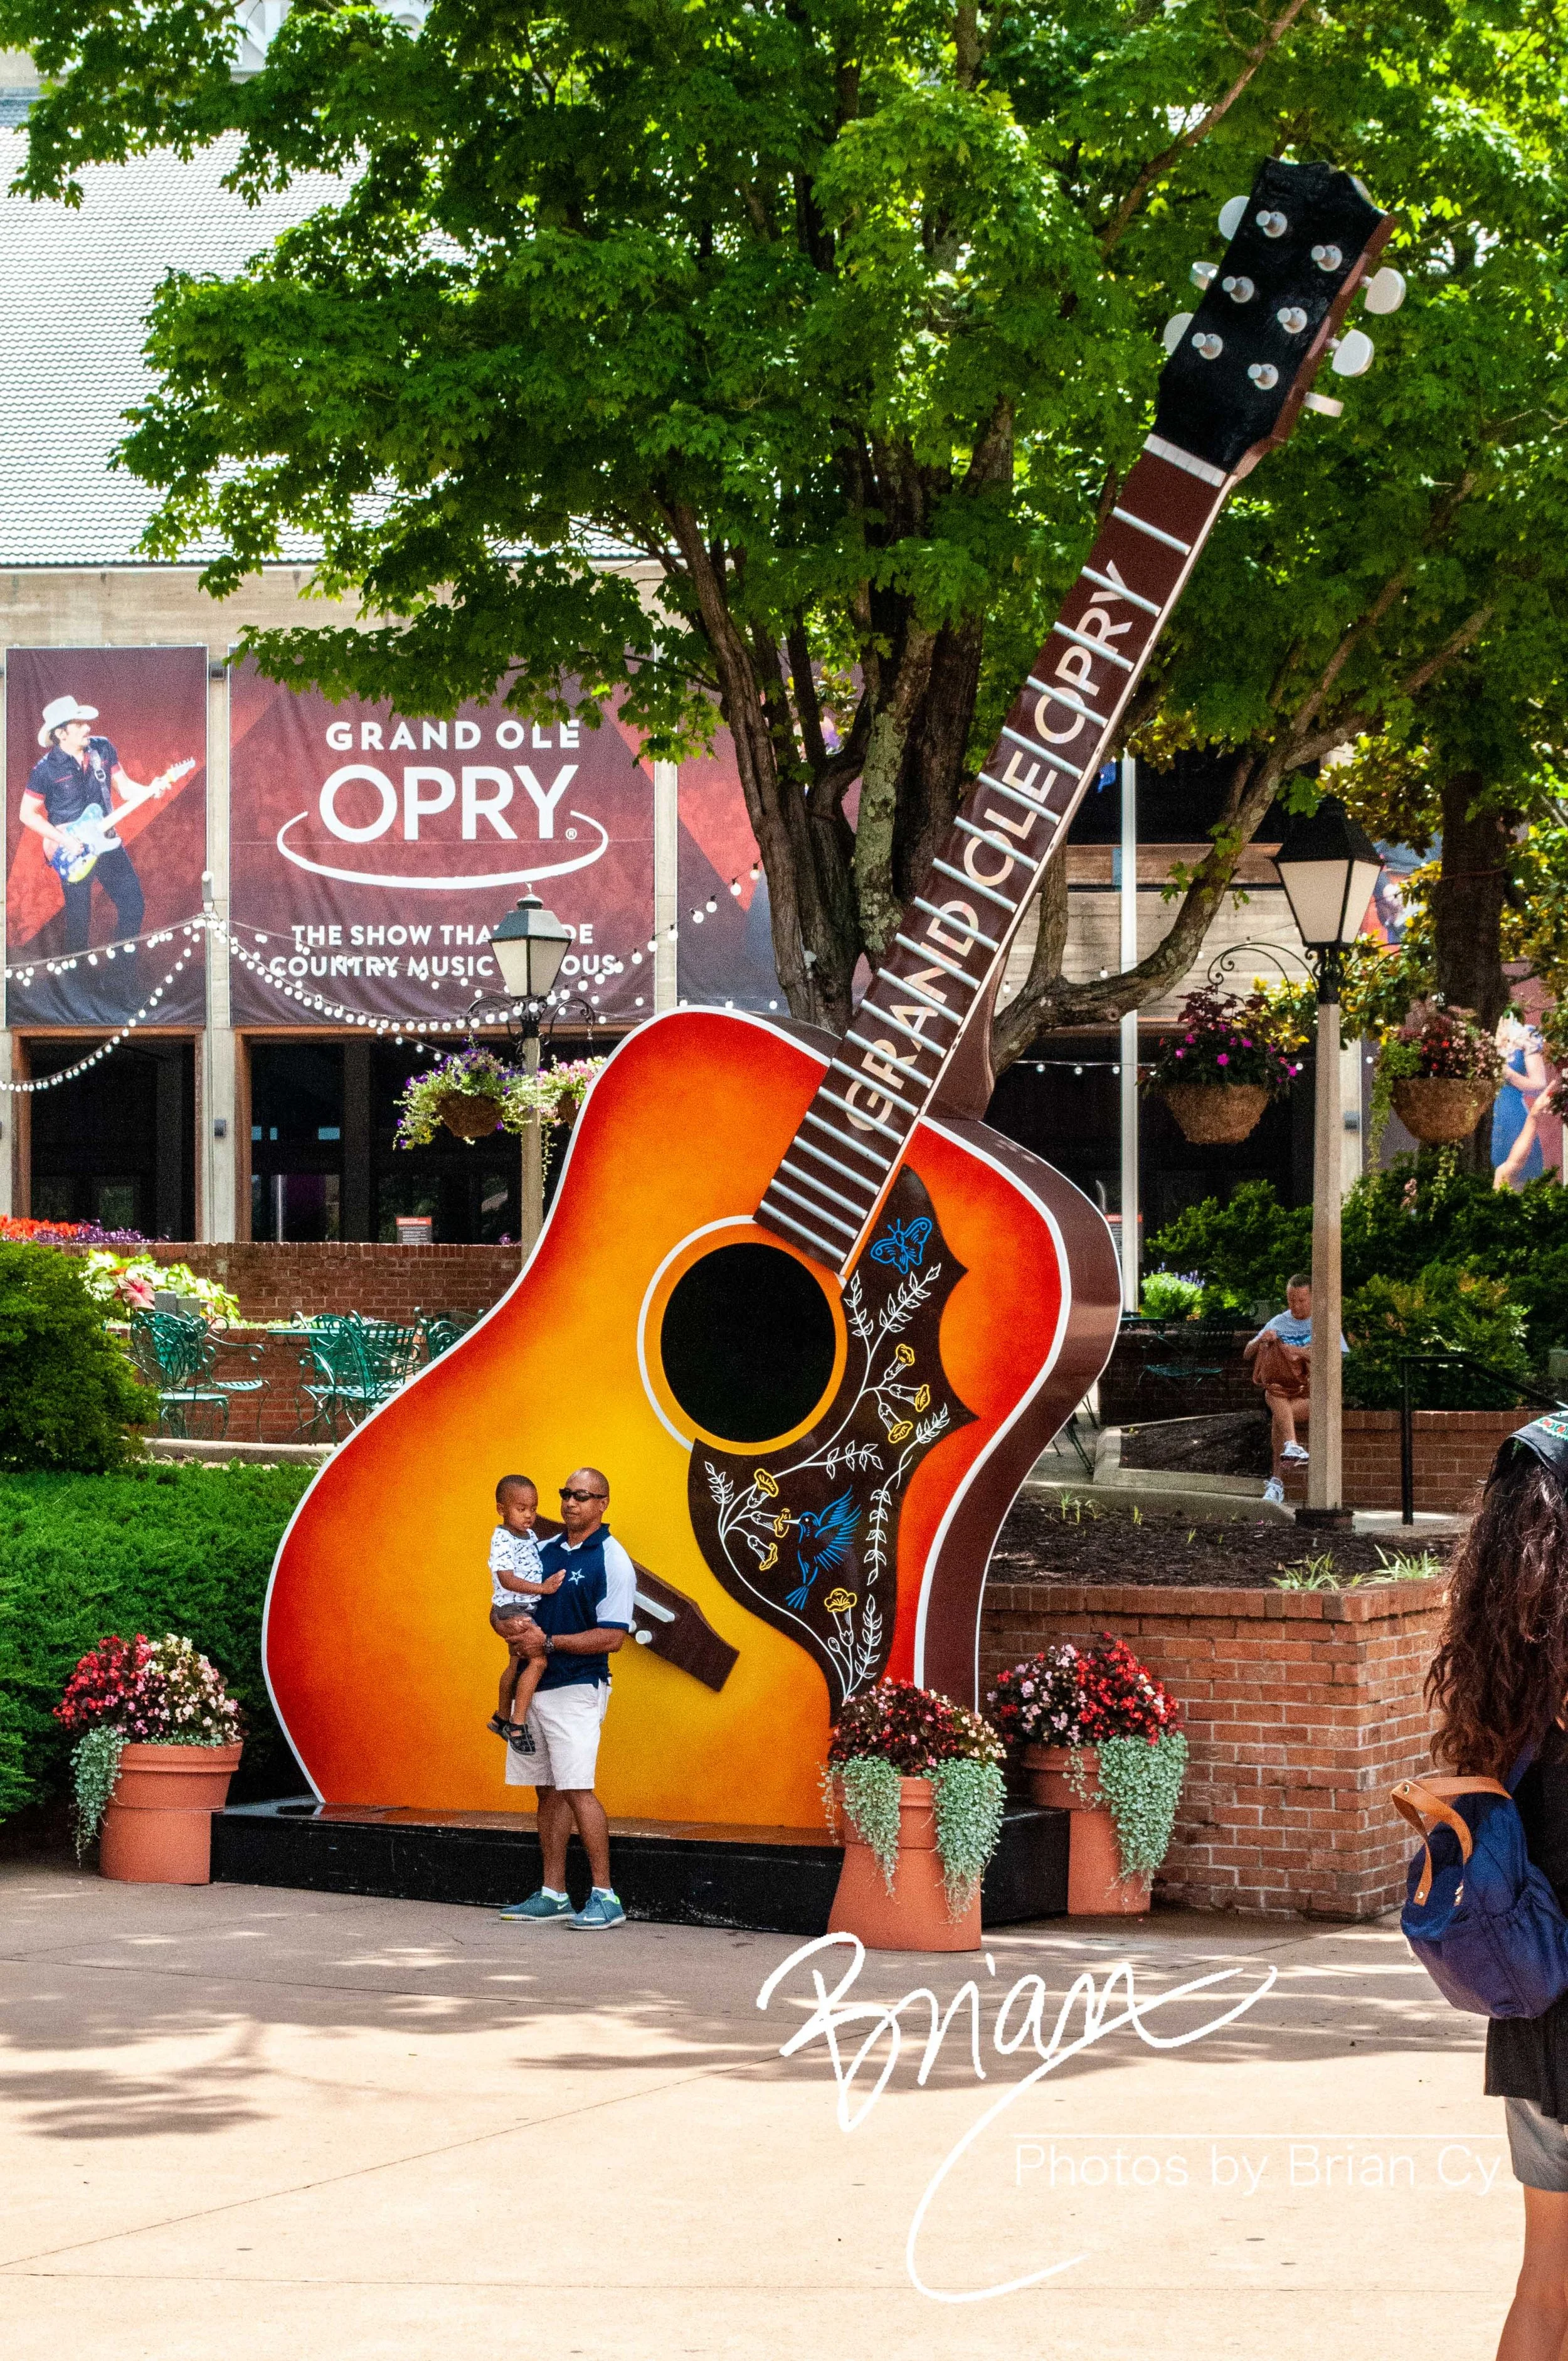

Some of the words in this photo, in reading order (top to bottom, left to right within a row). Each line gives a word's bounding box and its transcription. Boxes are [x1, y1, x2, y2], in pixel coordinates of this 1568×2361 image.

[325, 720, 481, 751] GRAND
[495, 719, 580, 749] OLE
[845, 901, 980, 1131] GRAND
[963, 751, 1058, 888] OLE
[1034, 559, 1134, 745] OPRY
[291, 925, 342, 945] THE
[350, 925, 432, 945] SHOW
[440, 924, 499, 945] THA
[269, 956, 400, 977] COUNTRY
[408, 955, 494, 977] MUSIC
